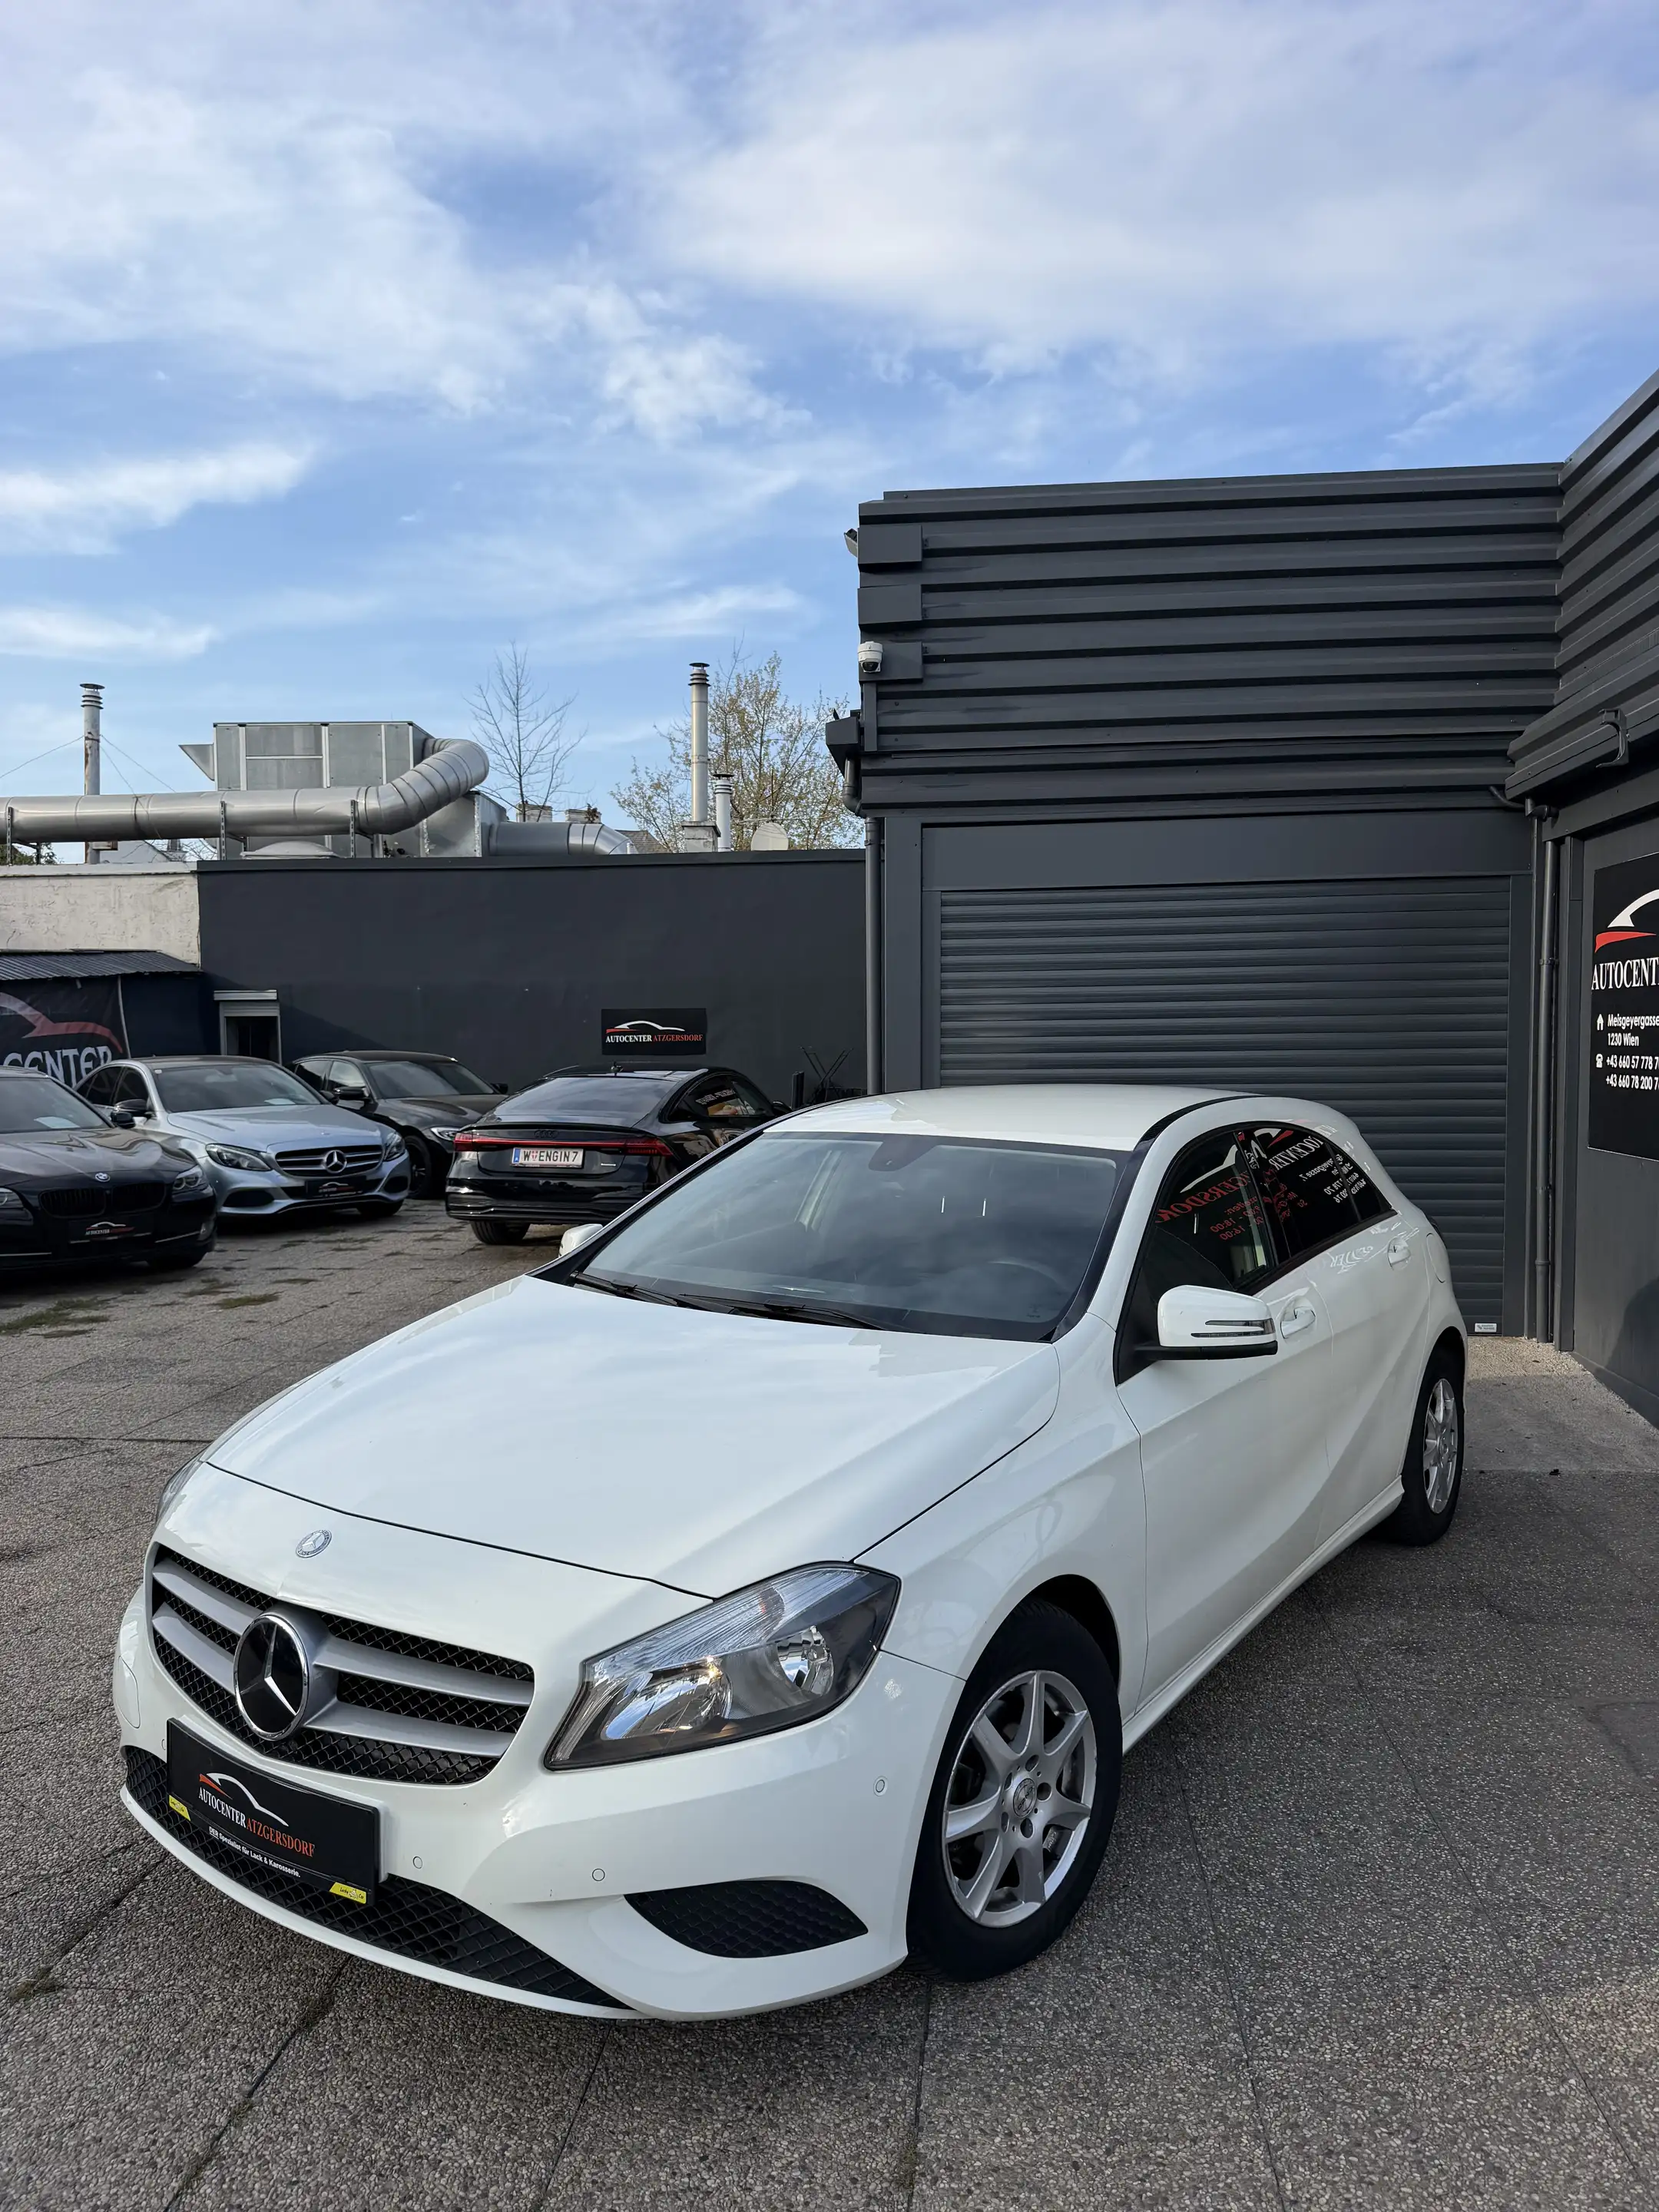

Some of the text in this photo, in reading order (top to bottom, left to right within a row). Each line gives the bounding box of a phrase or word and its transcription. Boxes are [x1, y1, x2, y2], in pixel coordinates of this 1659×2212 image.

[1591, 957, 1659, 990] AUTOCENT
[605, 1035, 652, 1043] AUTOCENTER
[1608, 1032, 1639, 1046] 1230 Wien
[1606, 1055, 1659, 1070] +43 660 57 778 7
[1606, 1074, 1659, 1090] +43 660 78 200 7
[198, 1786, 316, 1858] AUTOCENTER ATZGERSDORF
[209, 1826, 219, 1838] DER
[219, 1833, 242, 1851] Spezialist
[250, 1850, 263, 1863] Lack
[263, 1856, 268, 1865] &
[269, 1858, 301, 1878] Karosserie.
